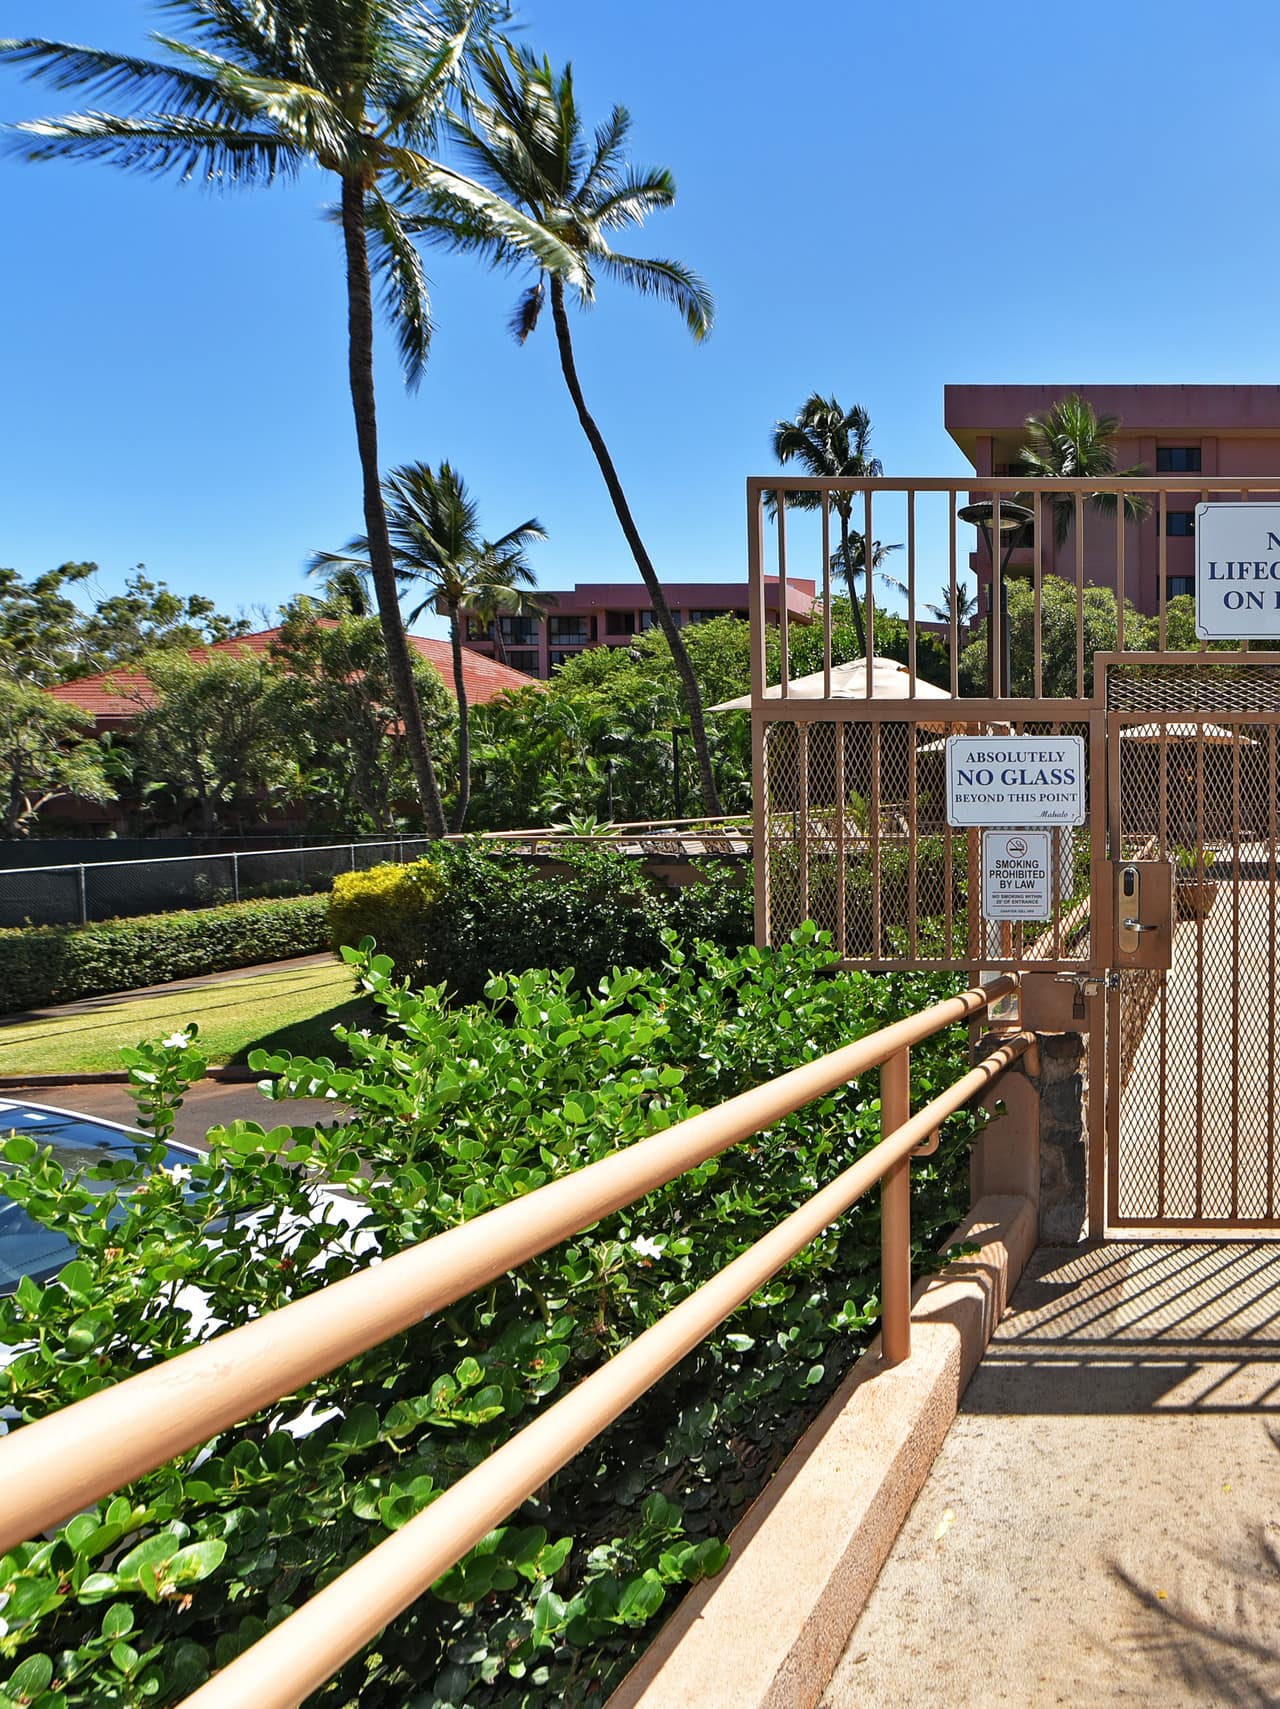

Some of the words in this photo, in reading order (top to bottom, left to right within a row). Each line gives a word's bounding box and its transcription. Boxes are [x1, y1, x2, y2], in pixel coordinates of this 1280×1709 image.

[1224, 591, 1264, 610] ON
[966, 752, 1066, 763] ABSOLUTELY
[957, 769, 994, 786] NO
[1001, 768, 1075, 786] GLASS
[955, 794, 1005, 803] BEYOND
[1008, 793, 1036, 803] THIS
[1039, 793, 1078, 802] POINT
[995, 860, 1039, 869] SMOKING
[990, 870, 1045, 879] PROHIBITED
[1000, 880, 1013, 889] BY
[1015, 880, 1035, 889] LAW
